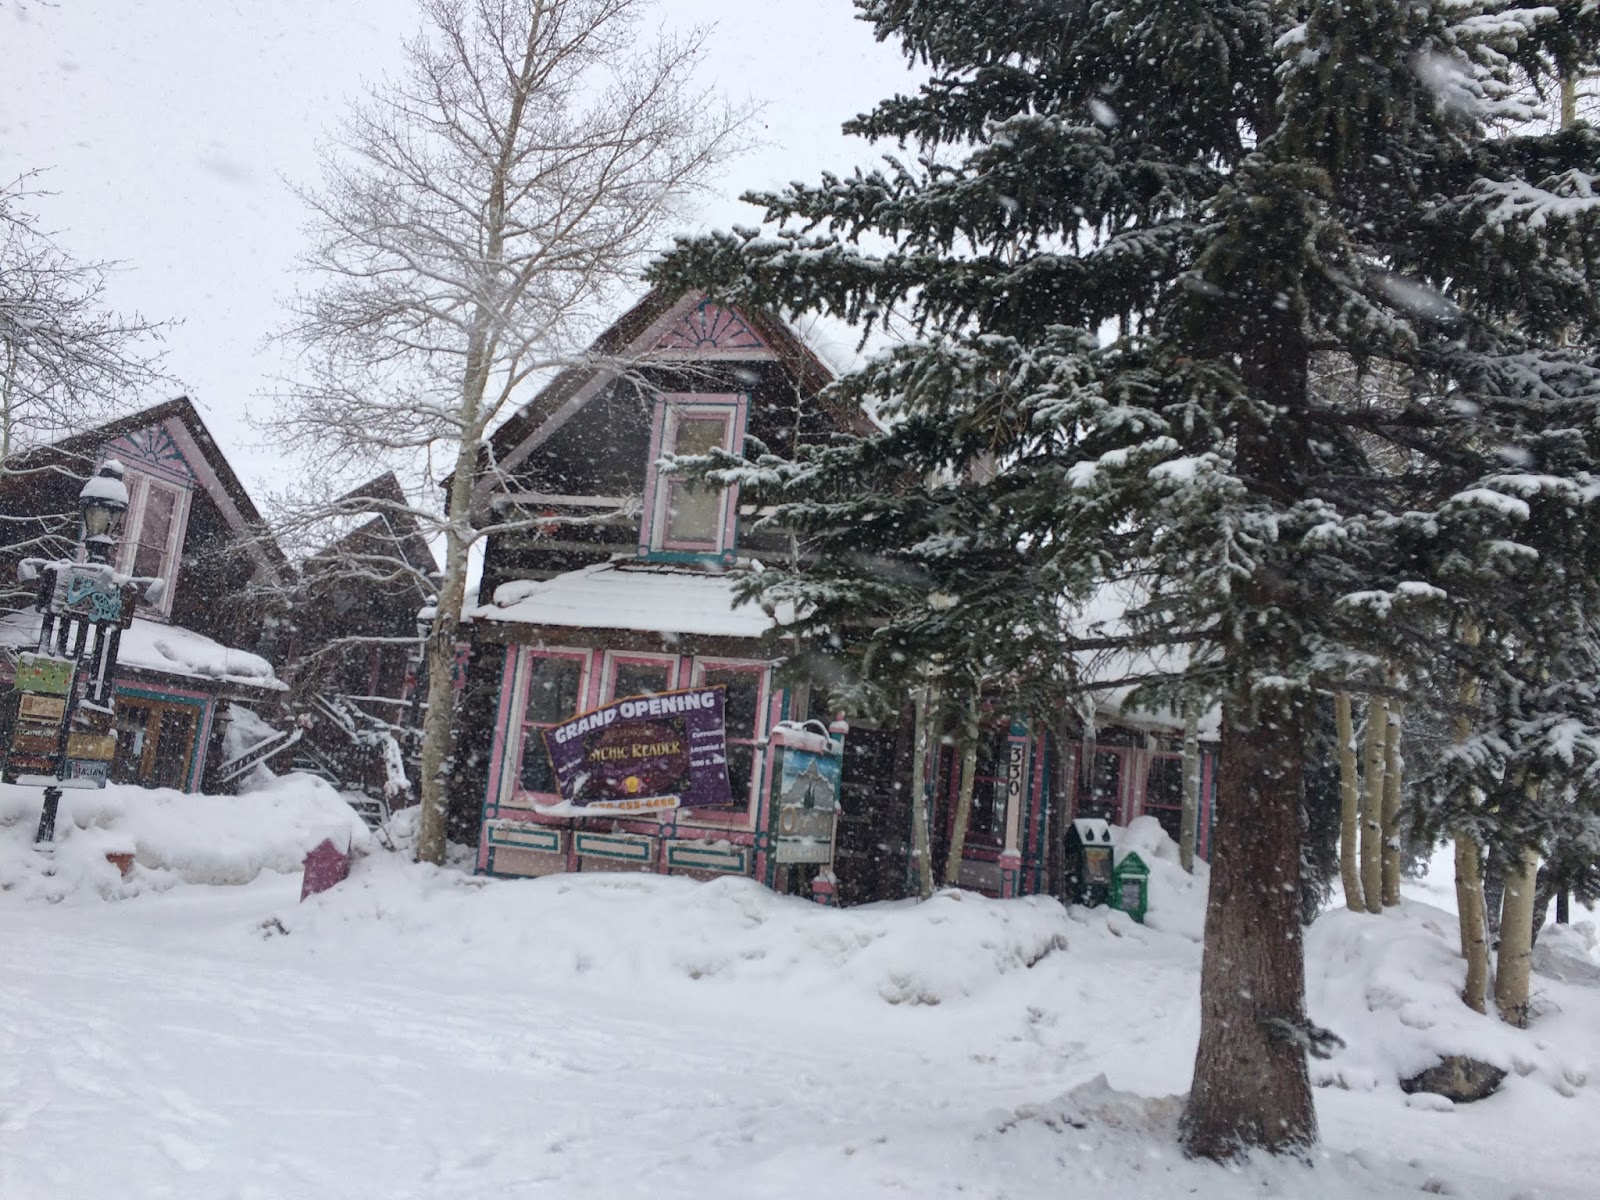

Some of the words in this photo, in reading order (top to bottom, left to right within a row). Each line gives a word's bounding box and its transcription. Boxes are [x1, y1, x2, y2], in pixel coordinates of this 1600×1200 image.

[555, 708, 618, 744] GRAND
[620, 692, 715, 718] OPENING
[632, 741, 680, 758] READER
[1010, 747, 1021, 796] 330
